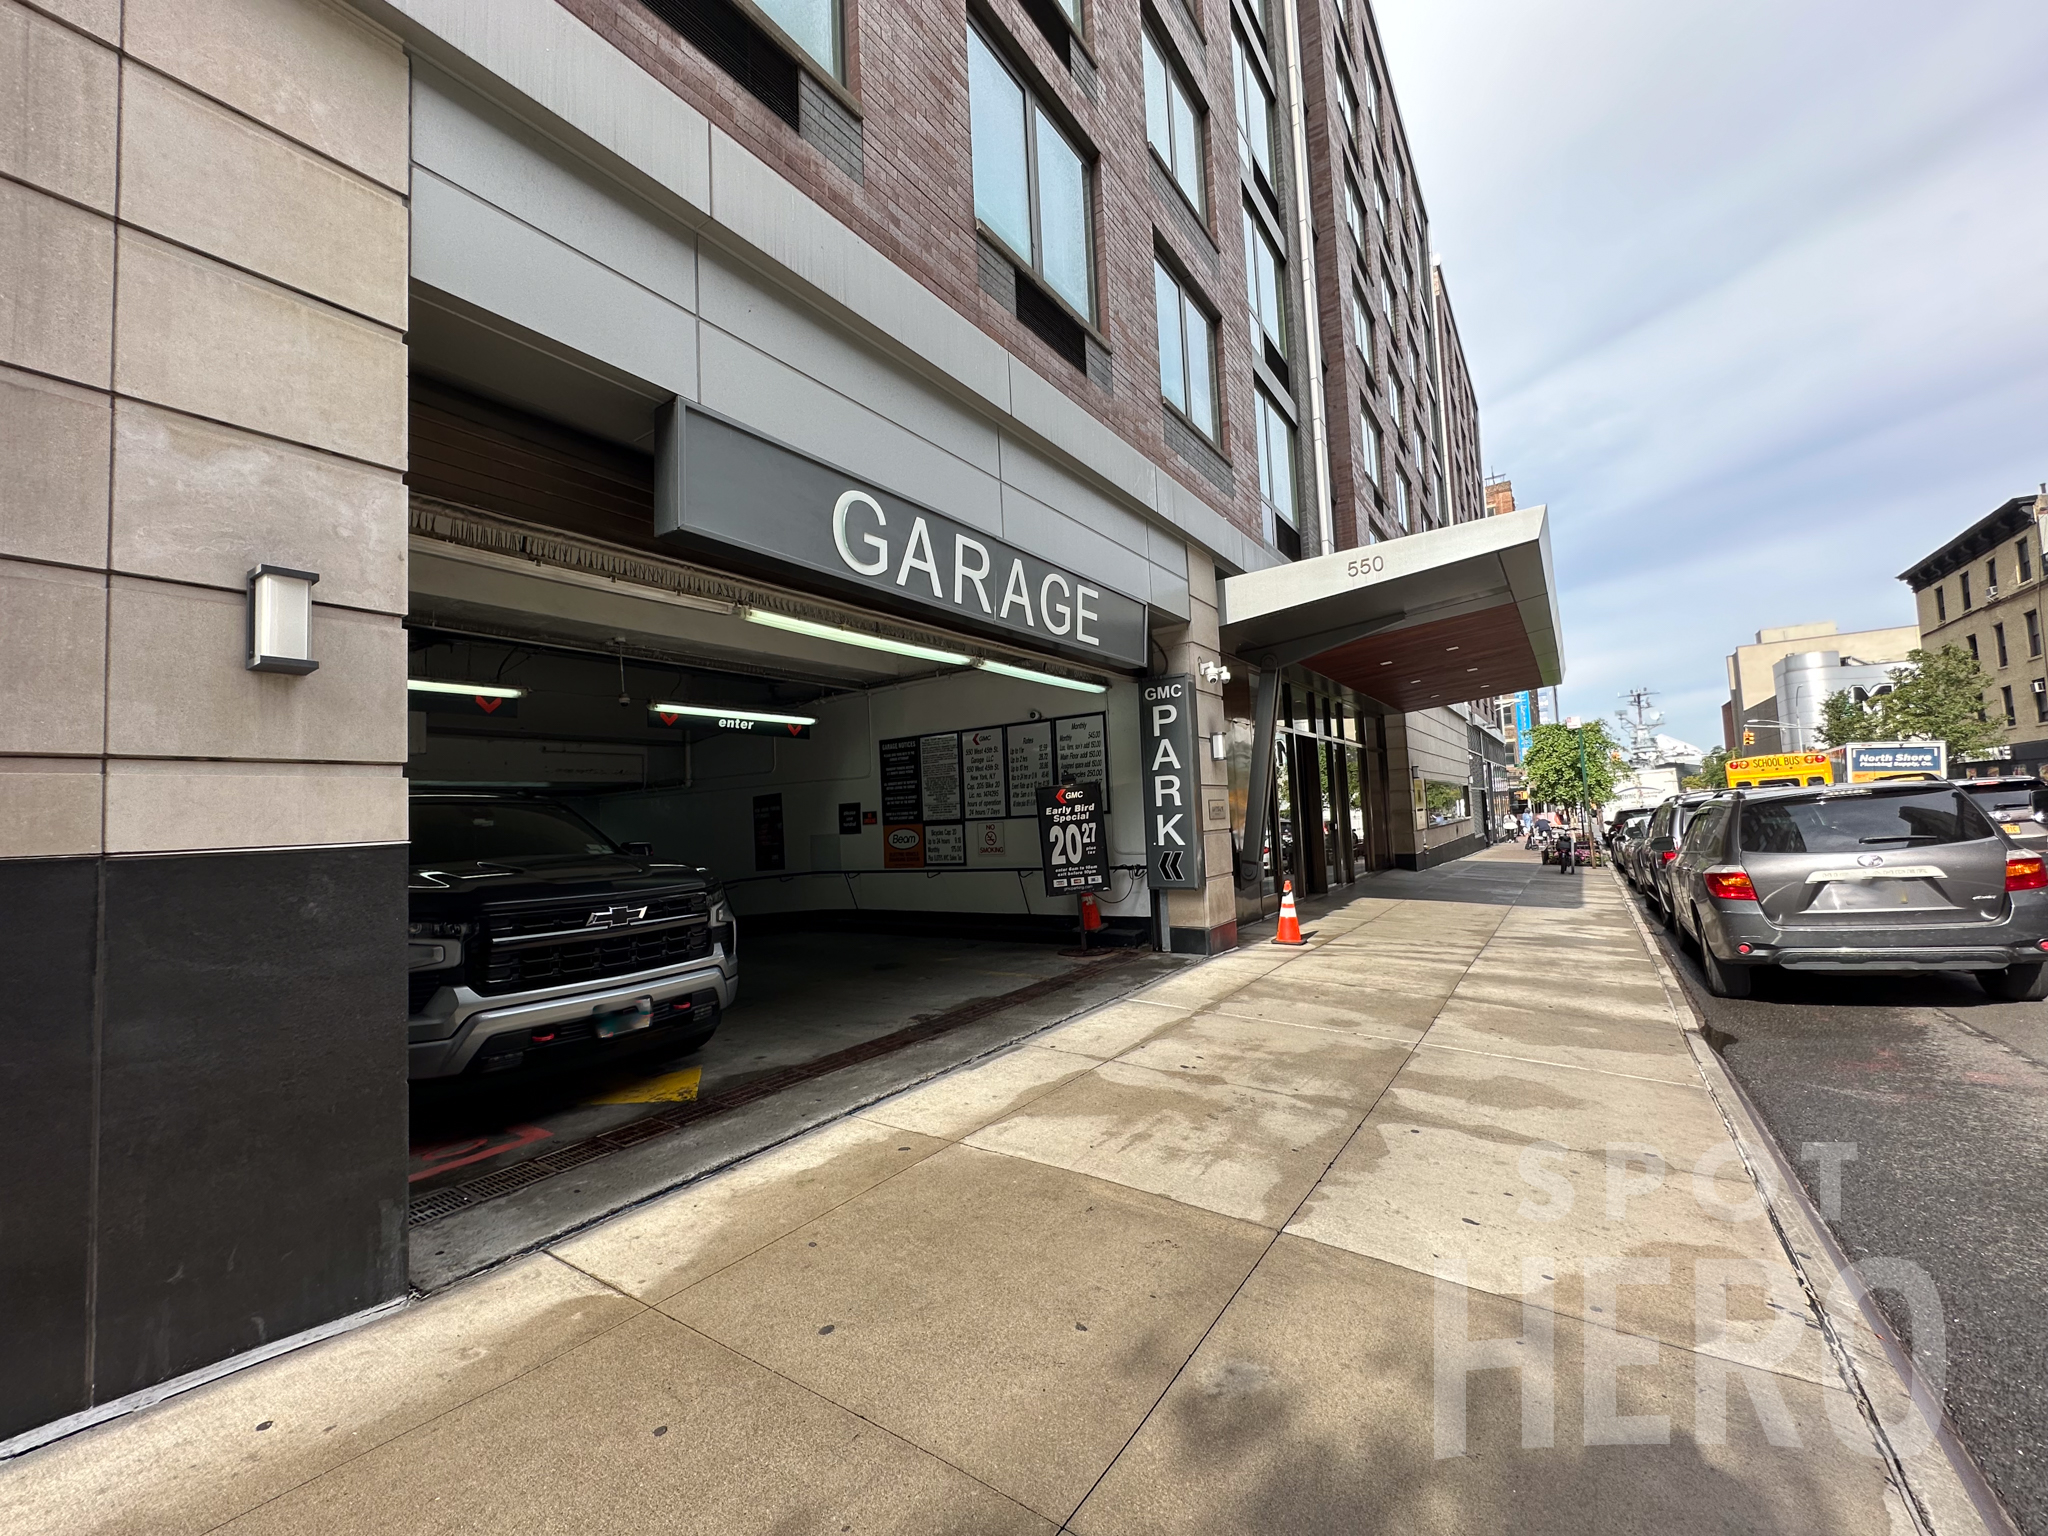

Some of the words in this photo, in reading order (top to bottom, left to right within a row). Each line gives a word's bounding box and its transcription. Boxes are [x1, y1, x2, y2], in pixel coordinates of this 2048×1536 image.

[832, 490, 1099, 646] GARAGE
[1348, 555, 1384, 577] 550
[1144, 684, 1182, 701] GMC
[718, 718, 754, 730] enter
[1071, 722, 1087, 730] Monthly
[1752, 757, 1783, 768] SCHOOL
[1784, 756, 1800, 767] BUS
[1859, 754, 1892, 762] North
[1895, 753, 1932, 762] Shore
[1087, 769, 1102, 777] 250.00
[1151, 704, 1186, 846] PARK
[1065, 790, 1084, 800] GMC
[1046, 806, 1072, 815] Early
[1074, 803, 1095, 812] Bird
[1053, 812, 1089, 823] Special
[892, 834, 916, 844] Beam
[1049, 824, 1082, 865] 20
[1082, 822, 1096, 844] 27
